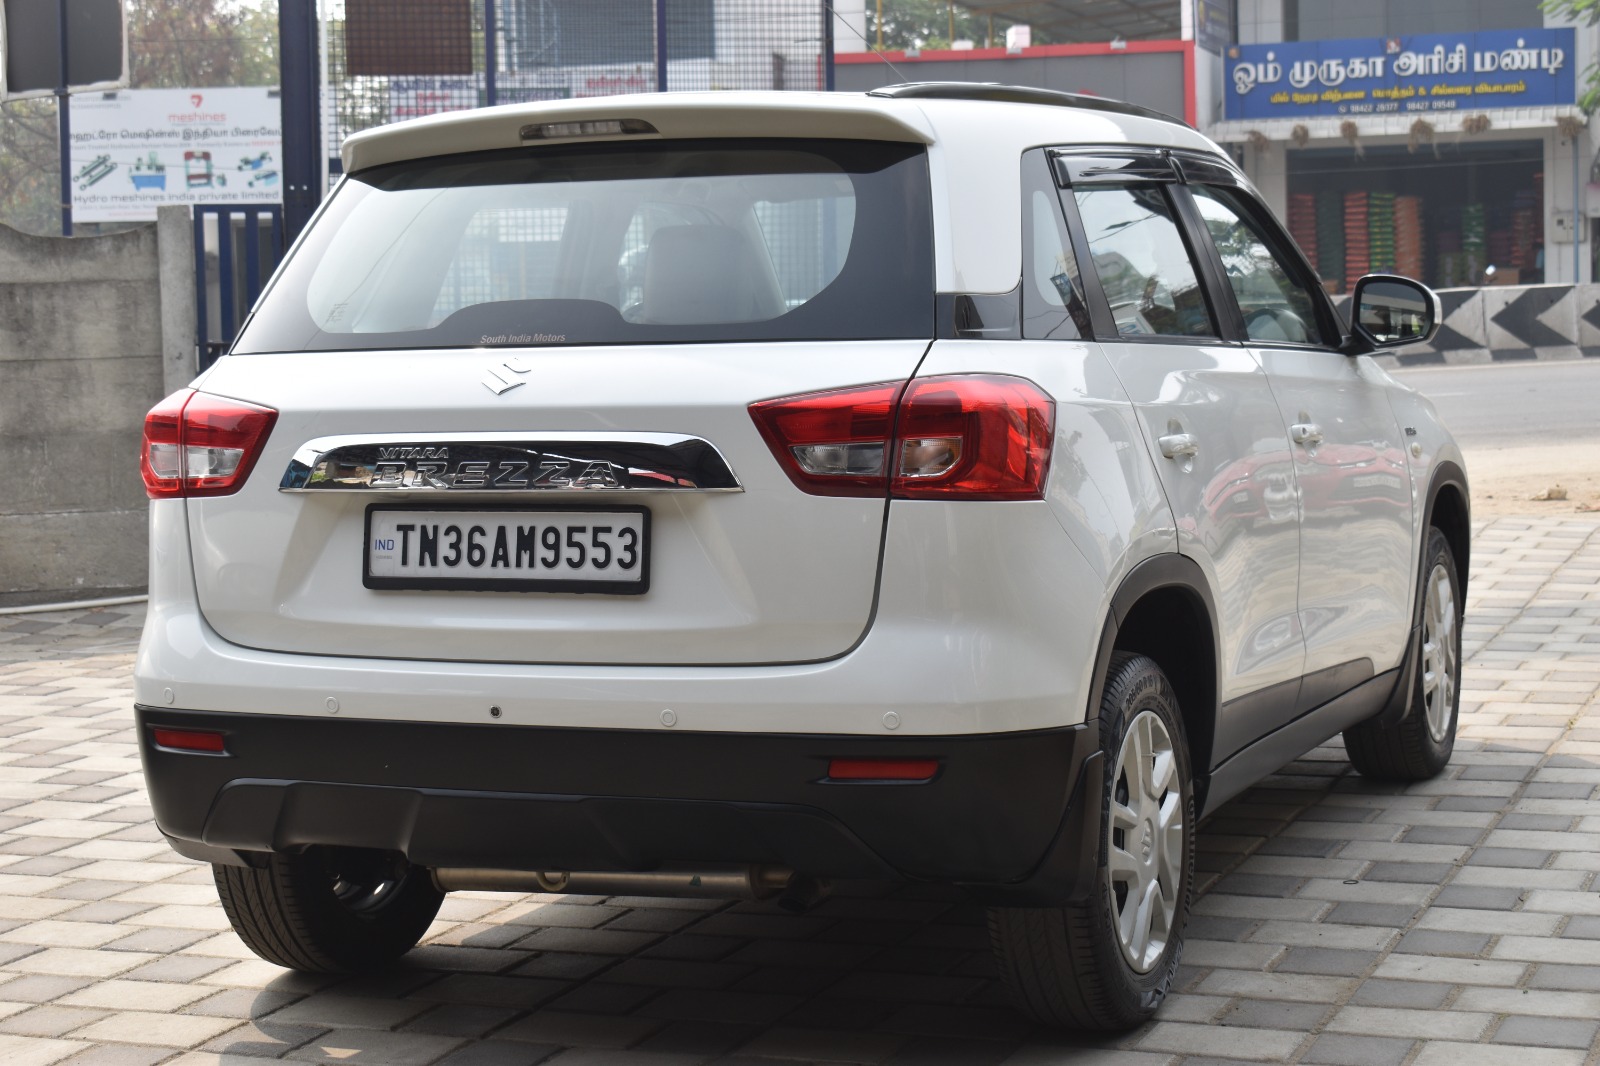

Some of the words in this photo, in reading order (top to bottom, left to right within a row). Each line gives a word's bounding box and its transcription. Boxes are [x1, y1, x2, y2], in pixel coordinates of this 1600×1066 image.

[1233, 51, 1282, 94] ஓம்
[1289, 56, 1385, 88] முருகா
[1393, 43, 1467, 77] அரிசி
[1474, 37, 1565, 75] மண்டி
[168, 111, 227, 122] meshines
[182, 127, 228, 141] இந்தியா
[74, 194, 108, 205] Hydro
[111, 193, 164, 202] meshines
[169, 192, 195, 201] india
[200, 192, 239, 202] private
[241, 191, 279, 200] limited
[480, 335, 506, 344] South
[508, 334, 531, 343] India
[533, 333, 566, 342] Motors
[379, 447, 449, 459] VITARA
[369, 460, 619, 489] BREZZA
[374, 538, 395, 551] IND
[396, 524, 638, 569] TN36AM9553
